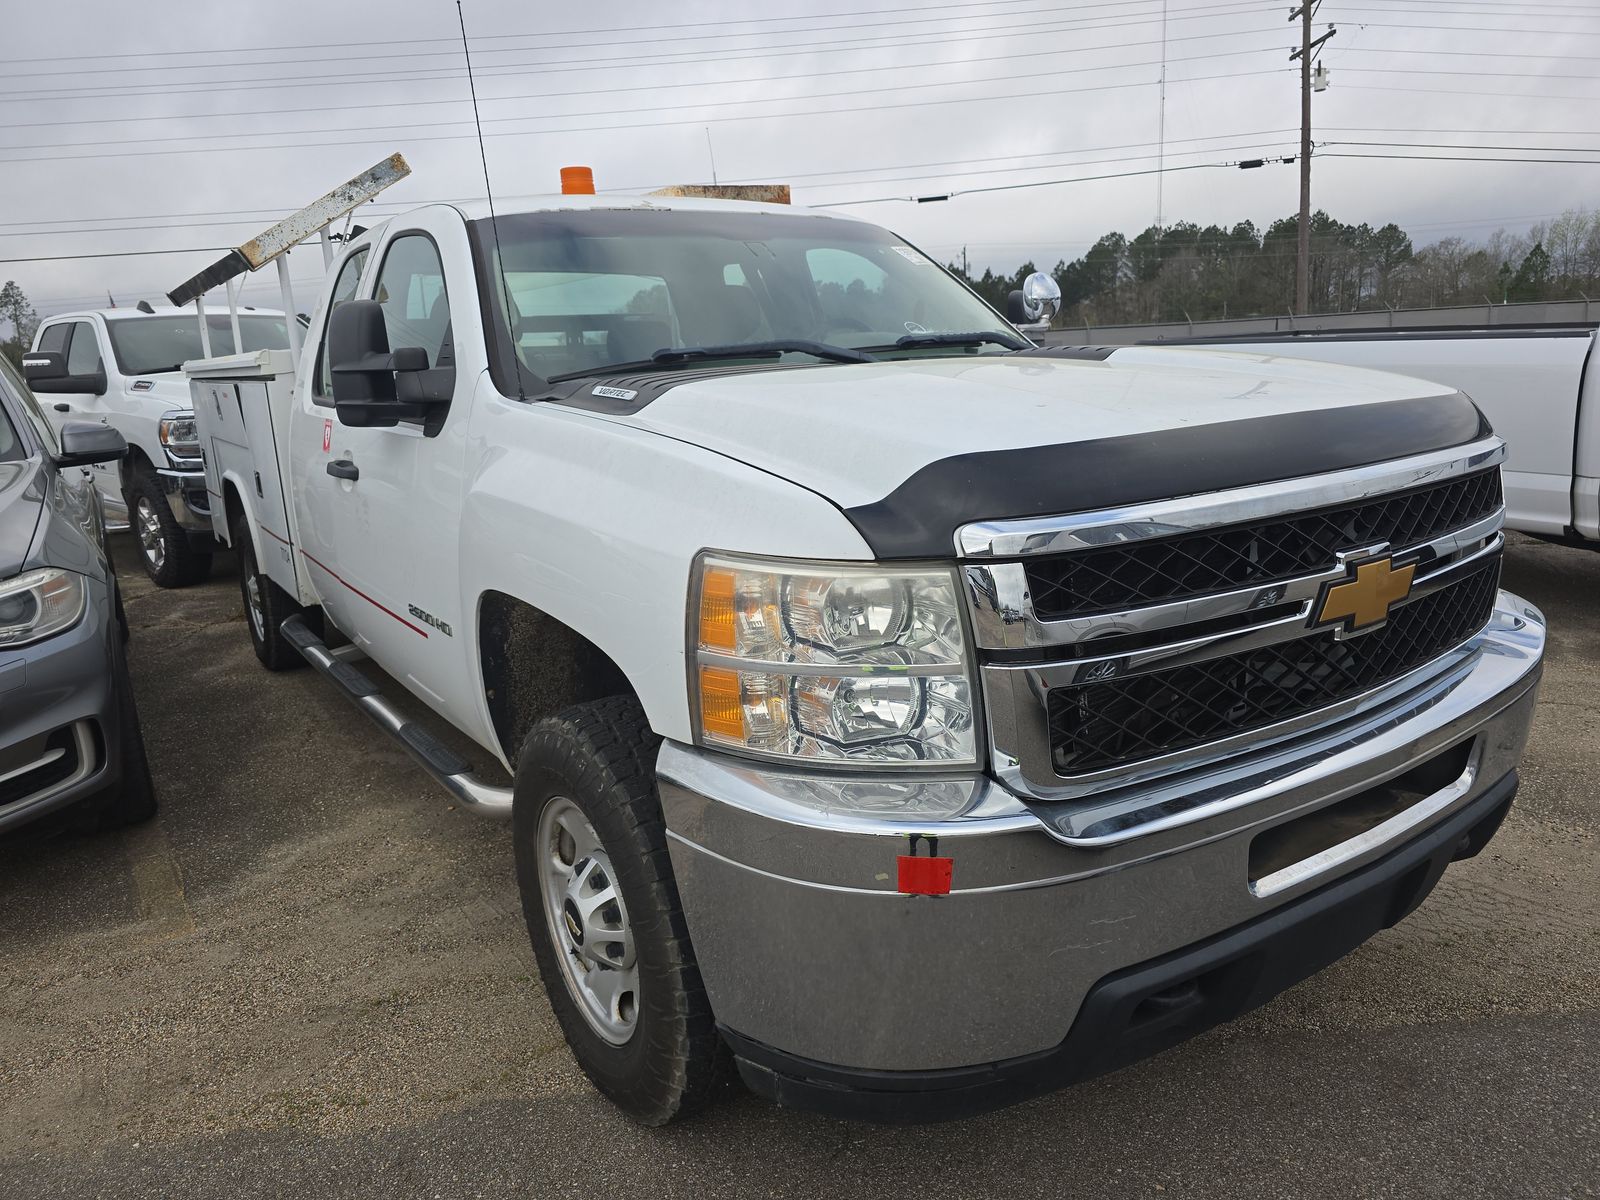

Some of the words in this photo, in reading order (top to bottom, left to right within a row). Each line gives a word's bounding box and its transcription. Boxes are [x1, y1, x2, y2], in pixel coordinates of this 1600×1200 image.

[598, 387, 630, 398] VORTEC
[408, 603, 435, 628] 2500
[435, 617, 453, 637] HD
